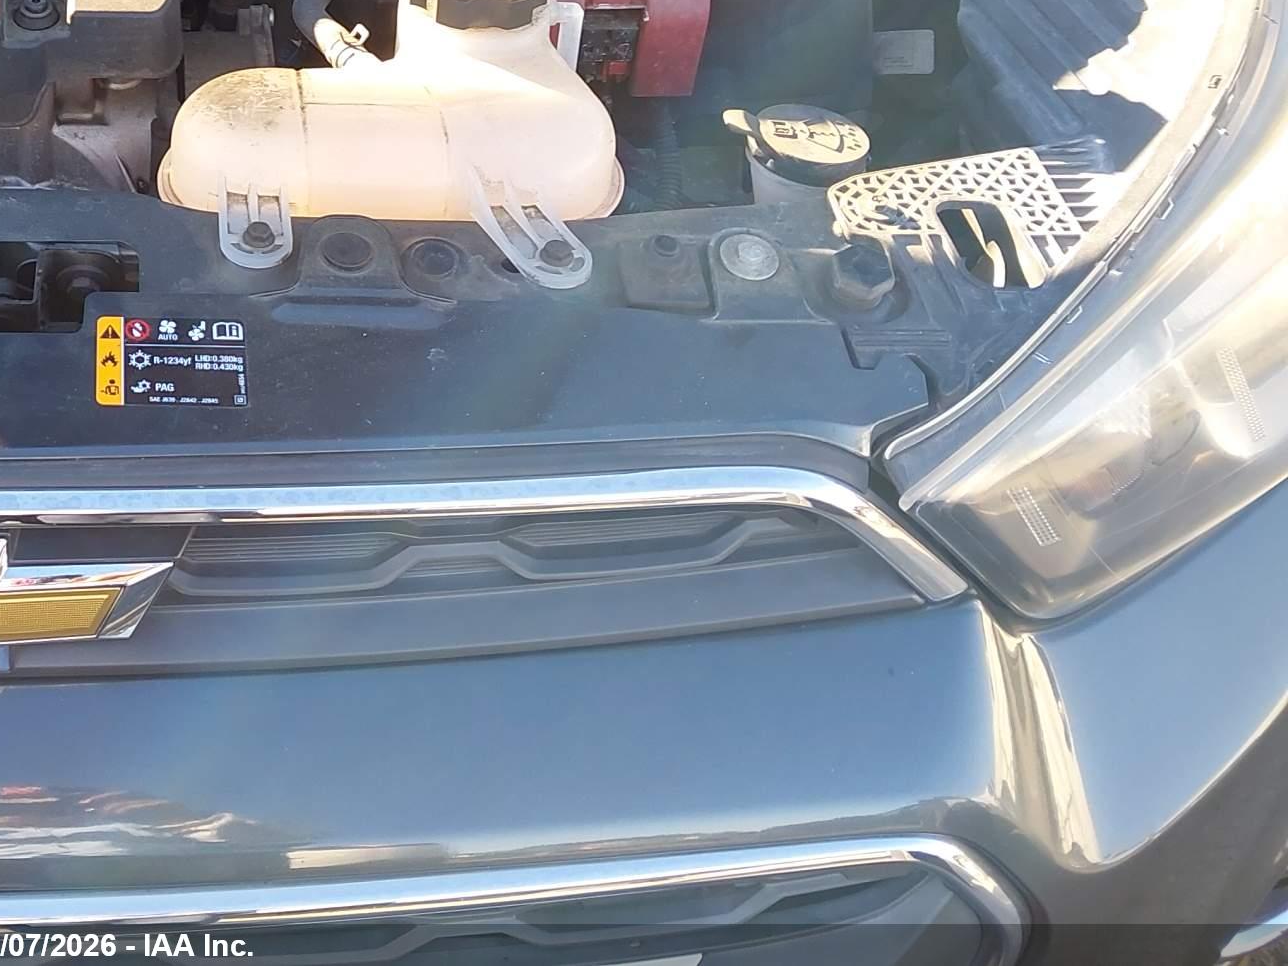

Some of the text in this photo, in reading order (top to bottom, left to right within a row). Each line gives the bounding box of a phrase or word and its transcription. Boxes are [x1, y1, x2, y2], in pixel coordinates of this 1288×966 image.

[157, 333, 178, 341] AUTO
[153, 356, 192, 367] R-1234yf
[155, 382, 175, 392] PAG
